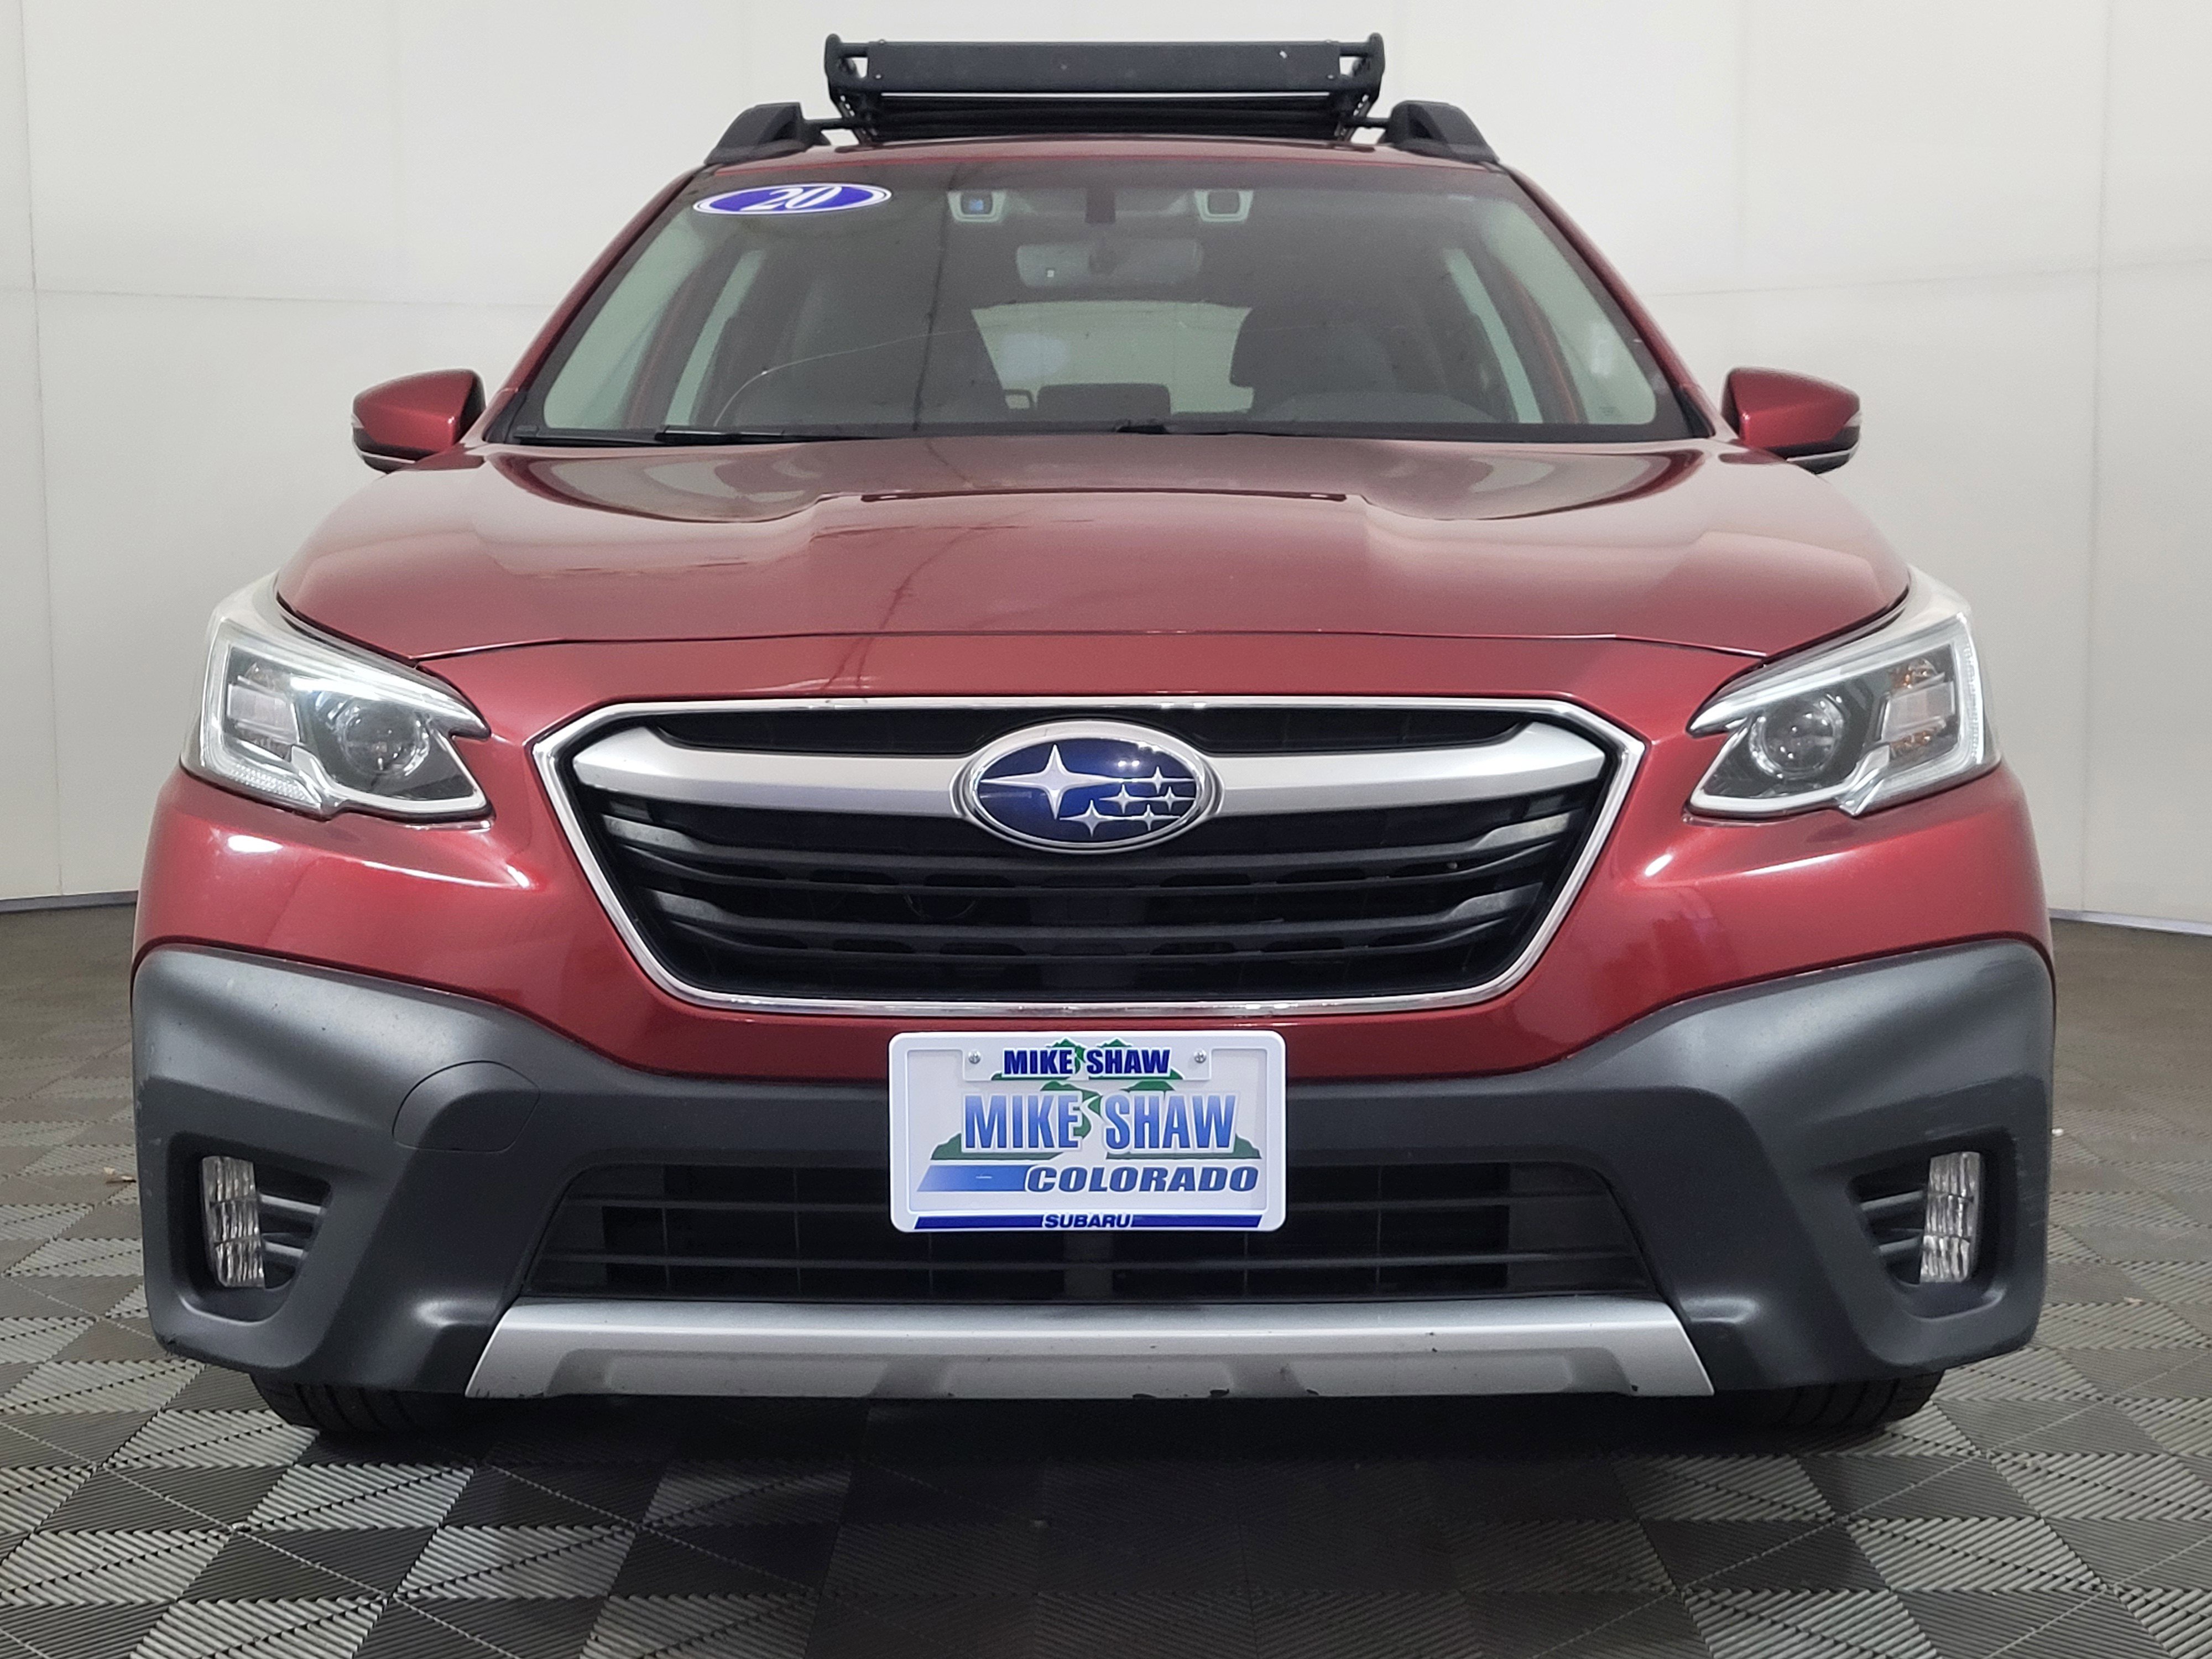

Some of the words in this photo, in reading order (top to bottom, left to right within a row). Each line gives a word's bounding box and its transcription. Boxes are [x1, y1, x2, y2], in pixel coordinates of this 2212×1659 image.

[739, 186, 843, 211] 20
[1004, 1049, 1074, 1074] MIKE
[1087, 1048, 1171, 1074] SHAW
[964, 1094, 1079, 1149] MIKE
[1105, 1094, 1237, 1150] SHAW
[1027, 1166, 1259, 1193] COLORADO
[1045, 1214, 1131, 1228] SUBARU
